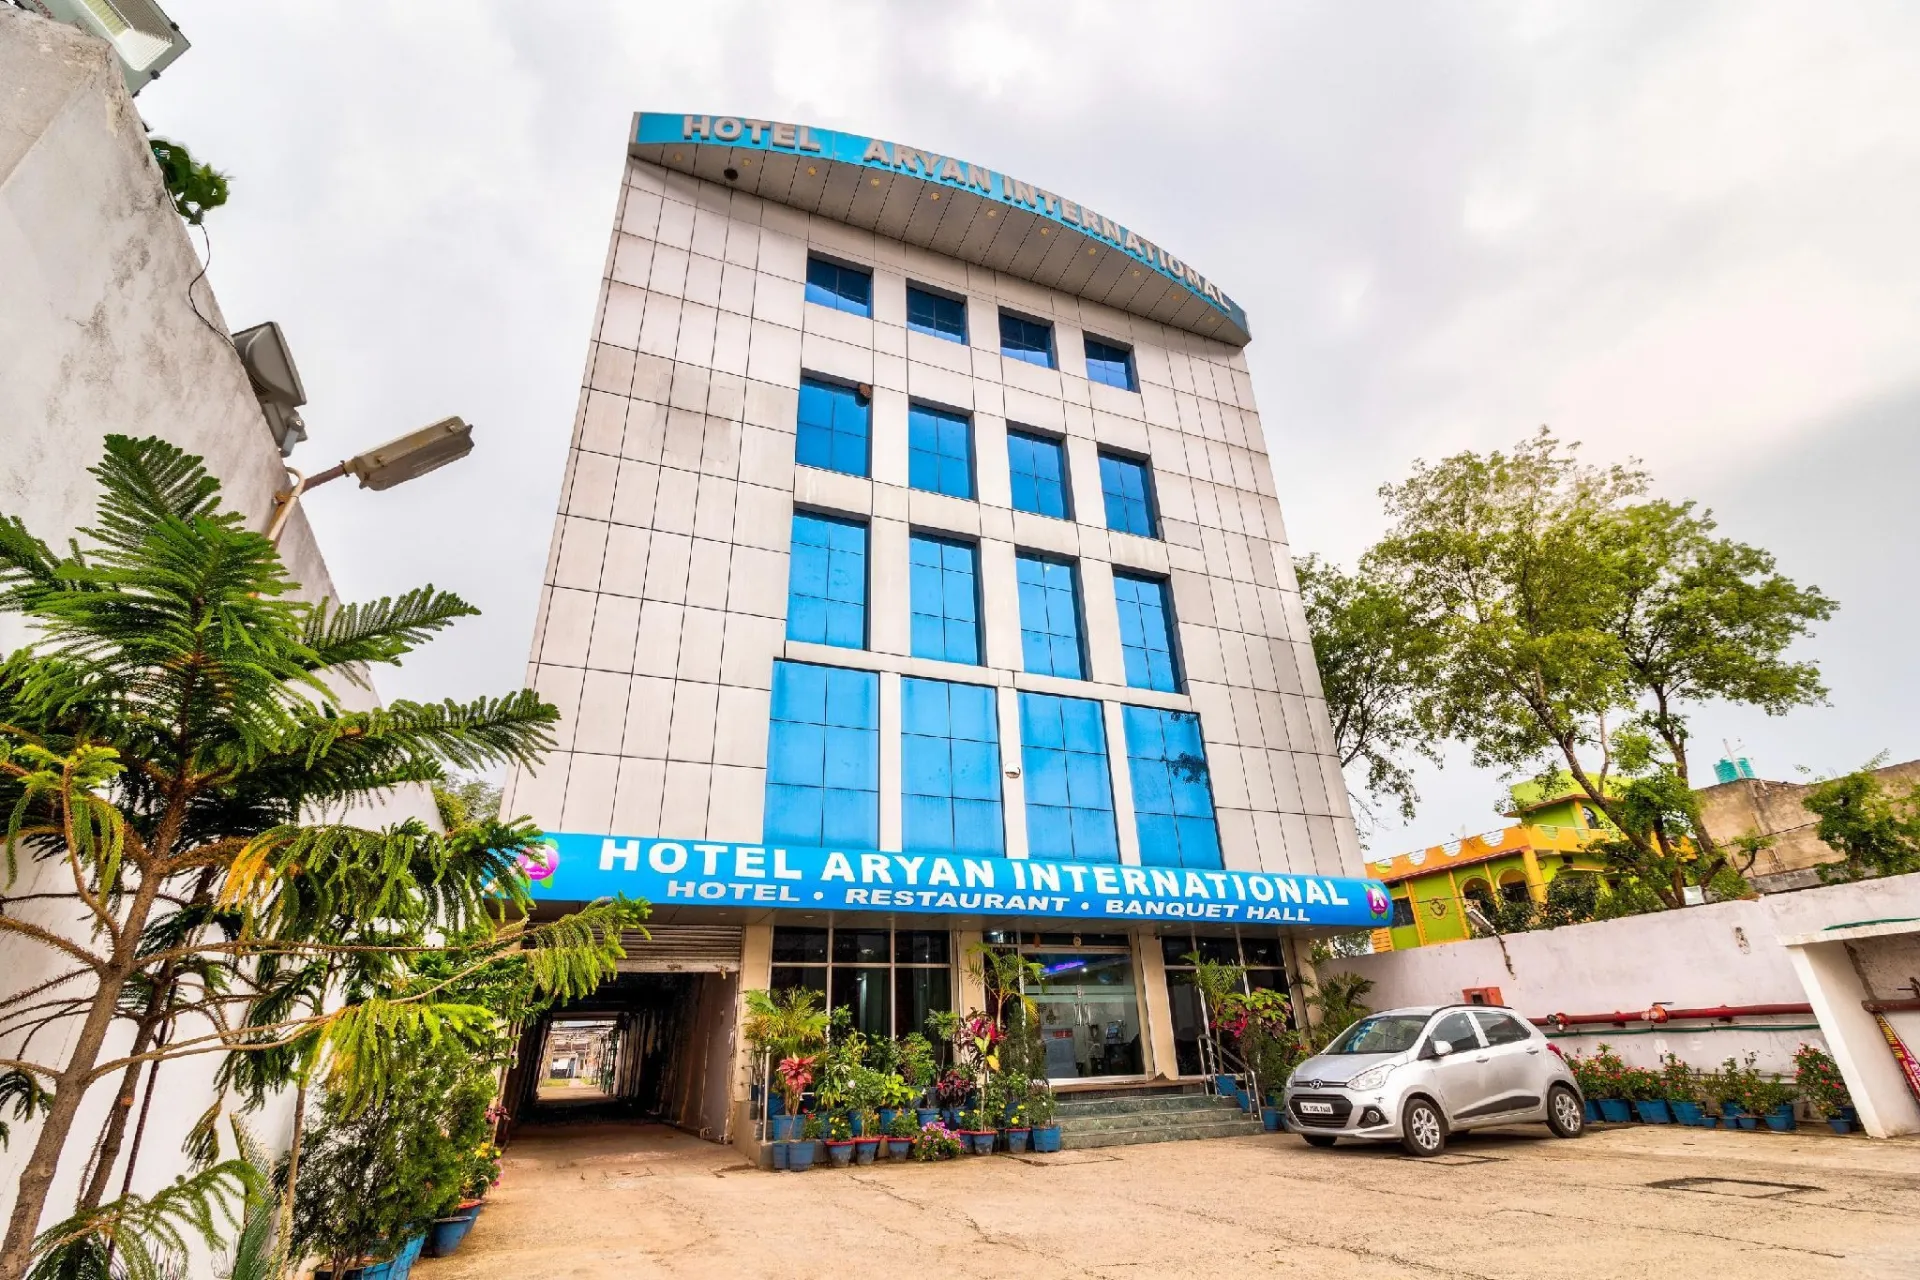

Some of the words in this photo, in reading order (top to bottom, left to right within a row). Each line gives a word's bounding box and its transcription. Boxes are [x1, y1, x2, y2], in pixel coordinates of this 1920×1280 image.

[684, 115, 821, 152] HOTEL
[863, 139, 991, 194] ARYAN
[1002, 174, 1231, 313] INTERNATIONAL
[599, 838, 802, 880] HOTEL
[820, 852, 995, 888] ARYAN
[1011, 861, 1349, 905] INTERNATIONAL
[667, 880, 800, 902] HOTEL
[845, 888, 1071, 912] RESTAURANT
[1105, 899, 1240, 918] BANQUET
[1246, 905, 1311, 922] HALL
